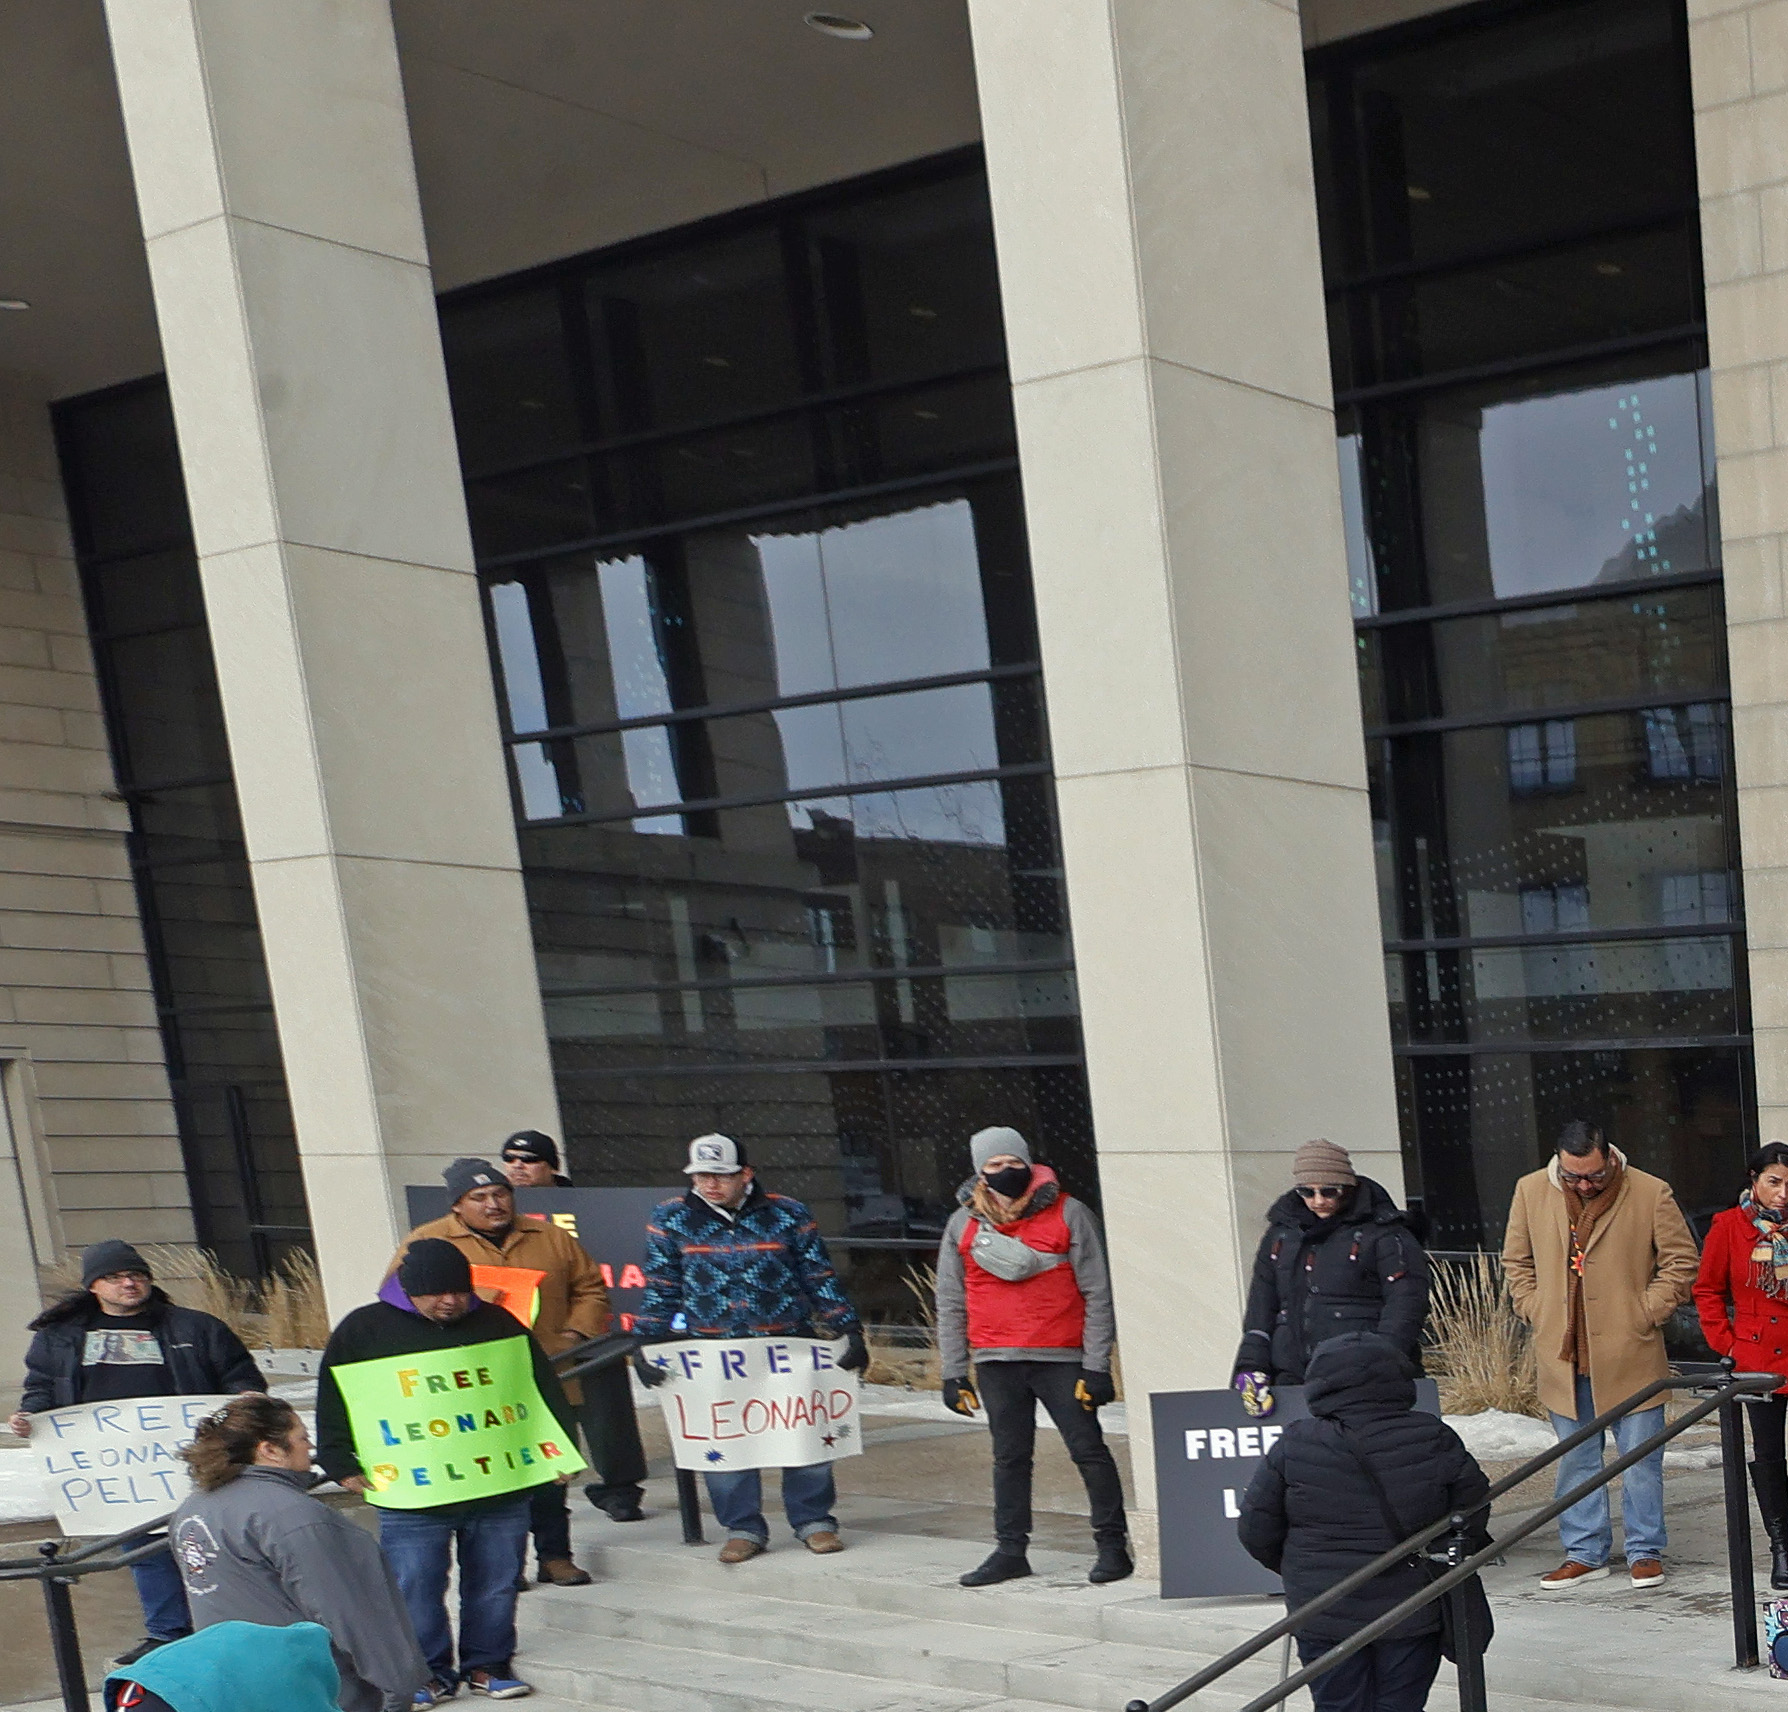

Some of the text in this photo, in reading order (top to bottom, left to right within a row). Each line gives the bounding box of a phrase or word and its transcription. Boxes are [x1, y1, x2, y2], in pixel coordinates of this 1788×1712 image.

[397, 1367, 494, 1398] FREE
[678, 1344, 834, 1381] FREE
[49, 1402, 207, 1439] FREE
[378, 1402, 528, 1447] LEONARD
[674, 1389, 853, 1441] LEONARD
[373, 1441, 563, 1492] PELTIER
[61, 1470, 177, 1512] PELT
